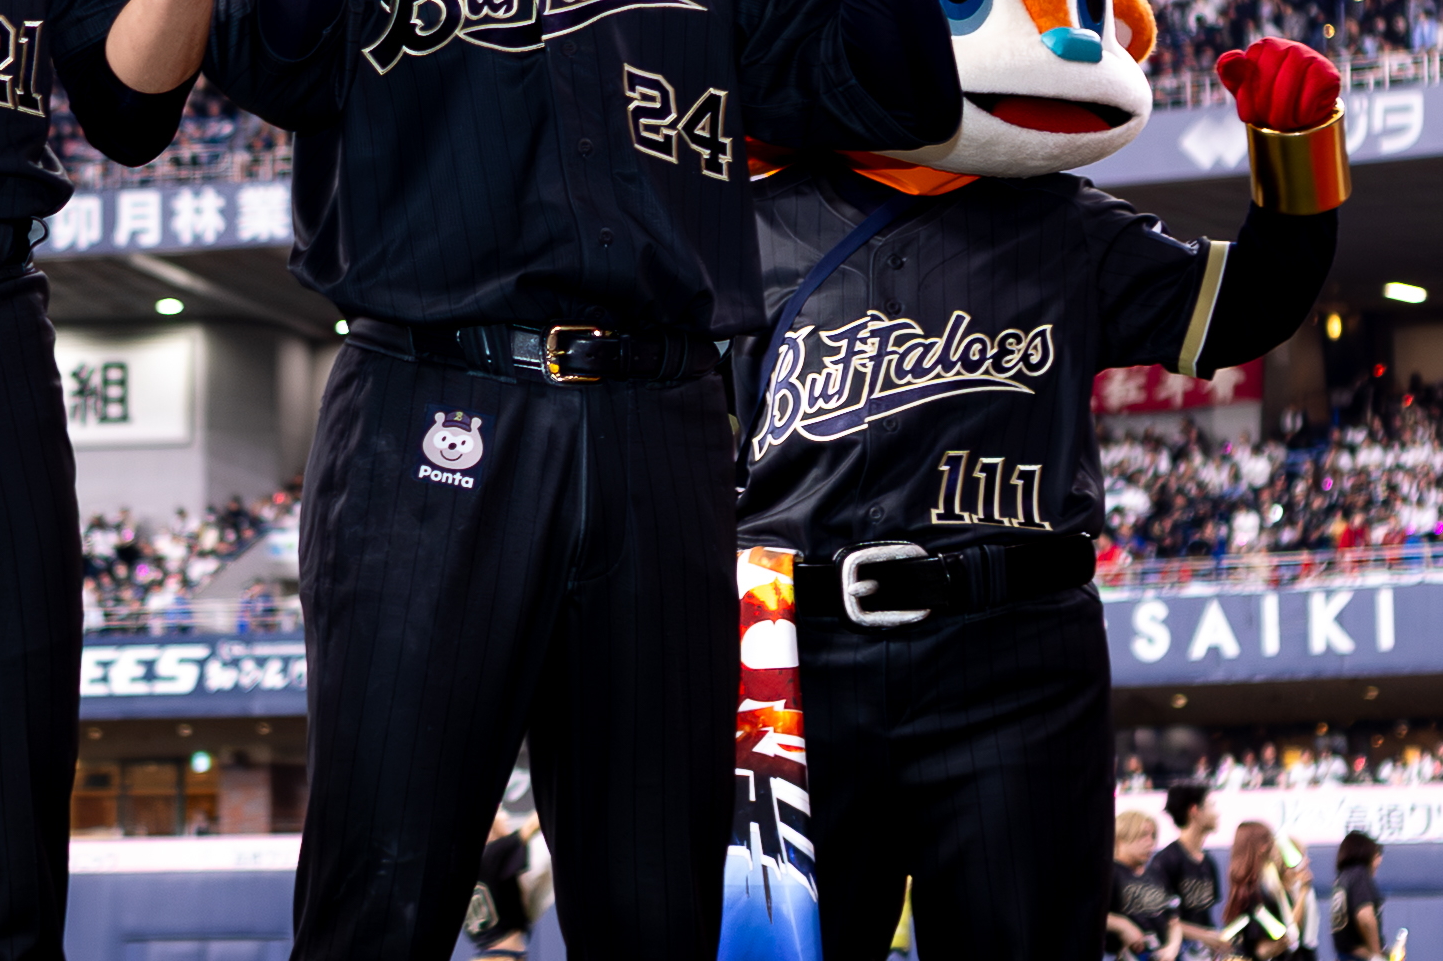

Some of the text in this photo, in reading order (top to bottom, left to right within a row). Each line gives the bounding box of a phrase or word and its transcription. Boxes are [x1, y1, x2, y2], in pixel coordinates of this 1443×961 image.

[623, 63, 732, 182] 24
[69, 361, 133, 425] 組
[753, 310, 1053, 460] Buffaloes
[418, 465, 474, 489] Ponta
[931, 451, 1053, 531] 111
[1130, 587, 1396, 663] SAIKI
